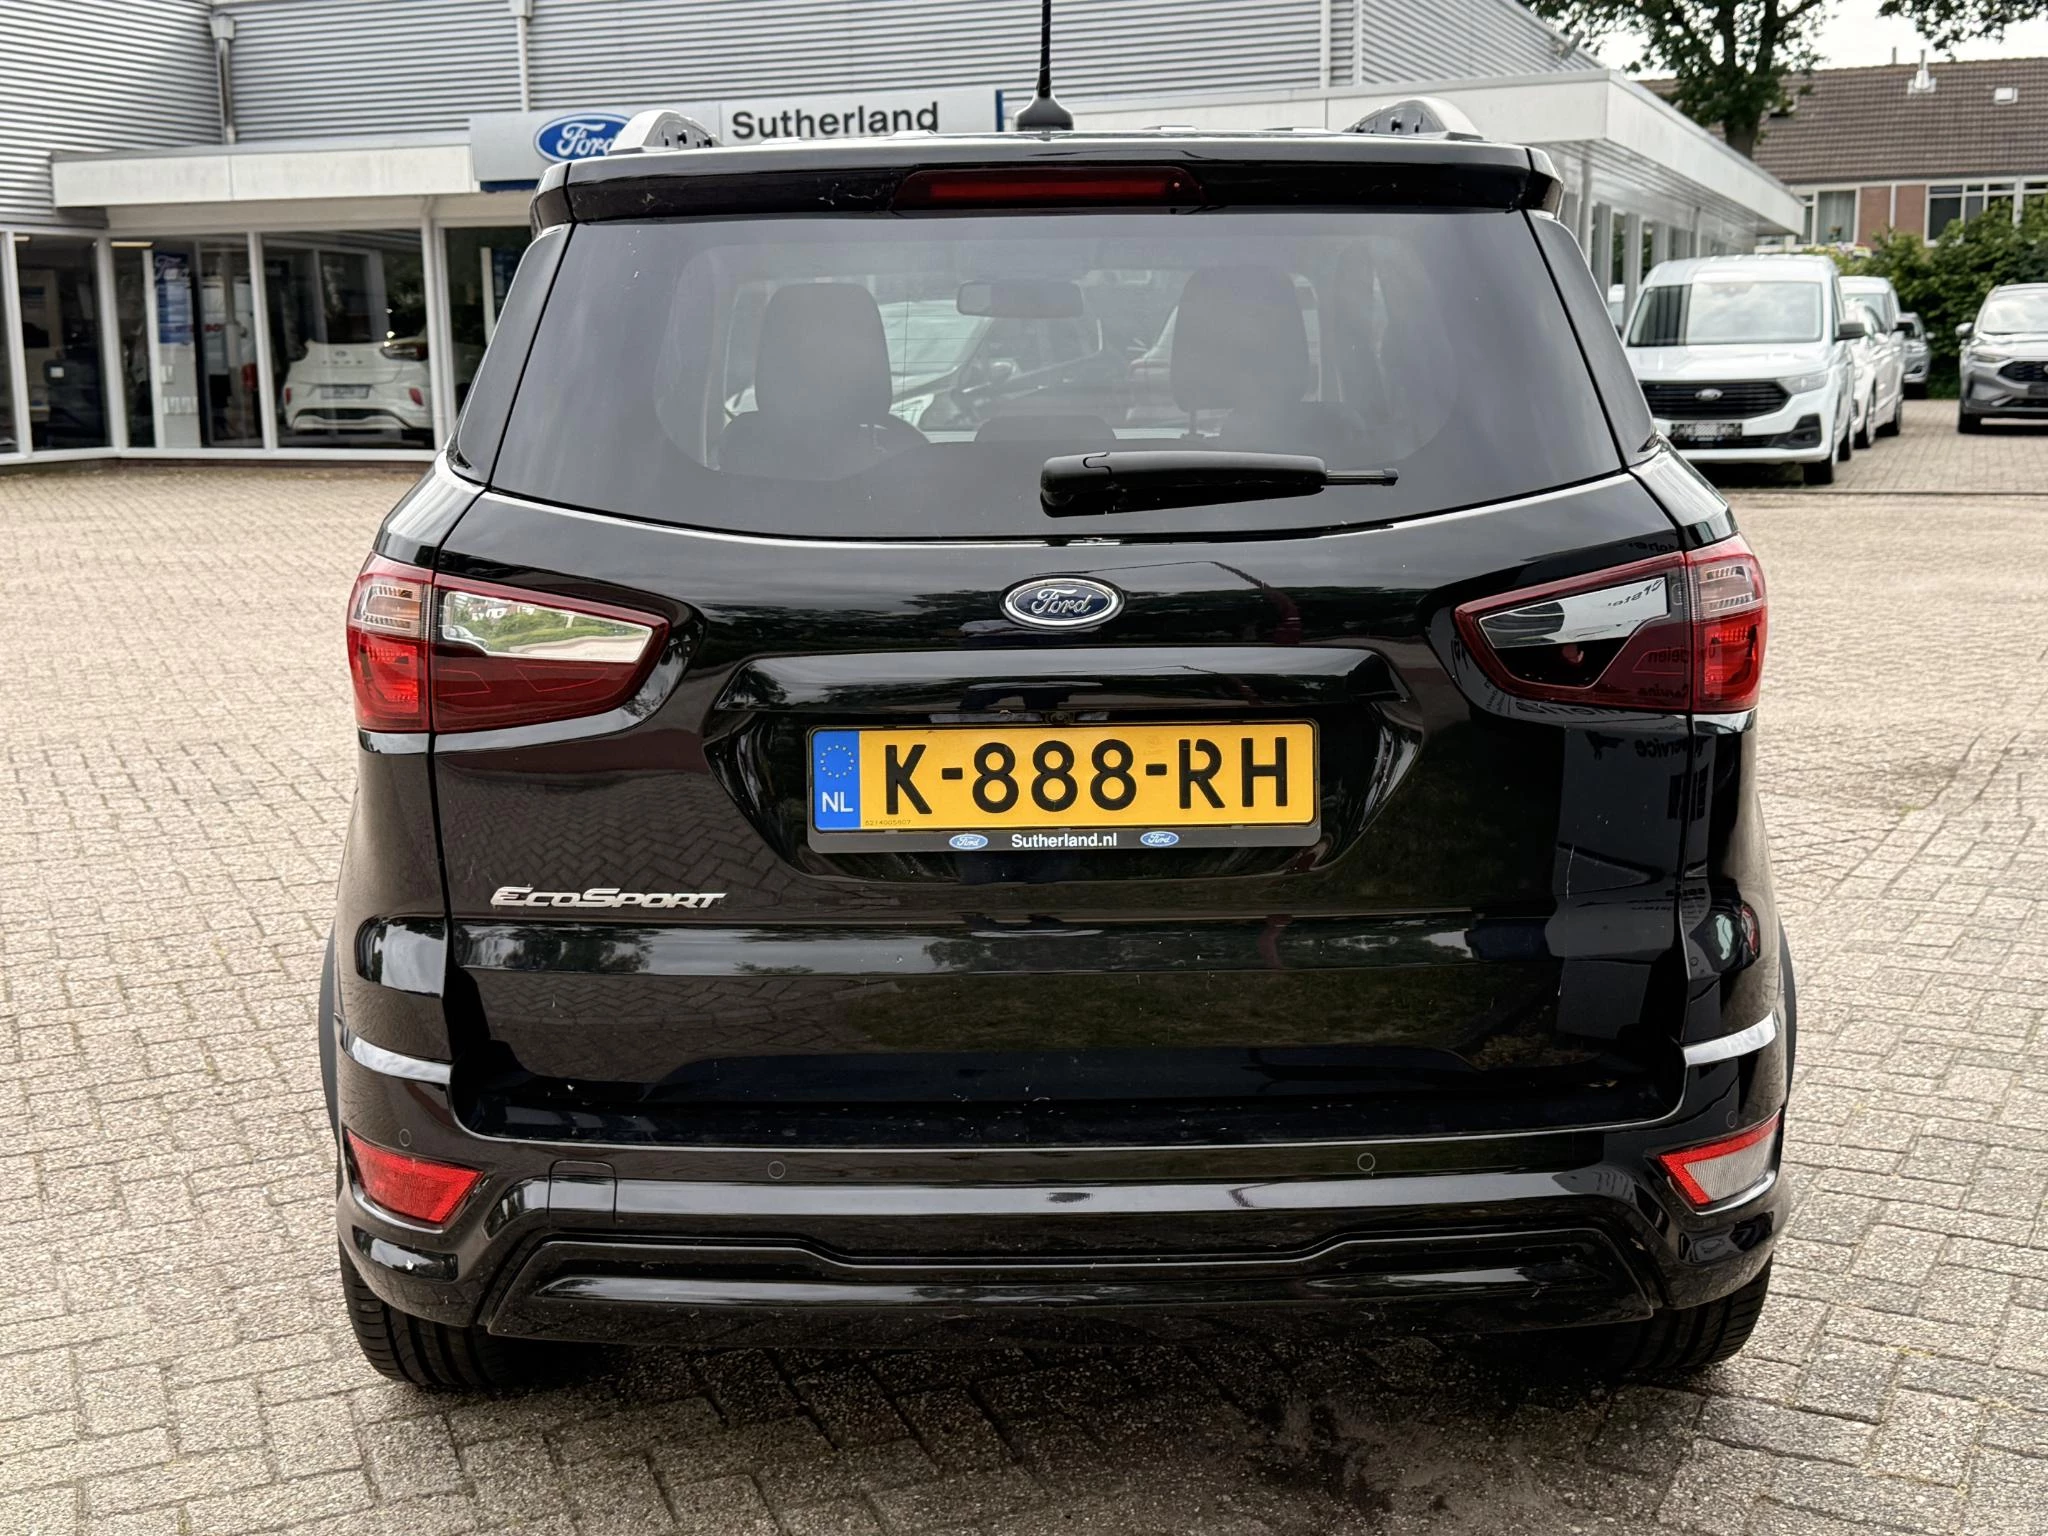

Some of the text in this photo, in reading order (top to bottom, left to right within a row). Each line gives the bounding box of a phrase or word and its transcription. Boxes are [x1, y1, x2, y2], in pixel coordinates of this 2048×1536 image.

[732, 102, 939, 139] Sutherland
[1031, 588, 1092, 614] Ford
[884, 736, 1288, 815] K-888-RH
[821, 792, 854, 813] NL
[1011, 832, 1118, 848] Sutherland.nl
